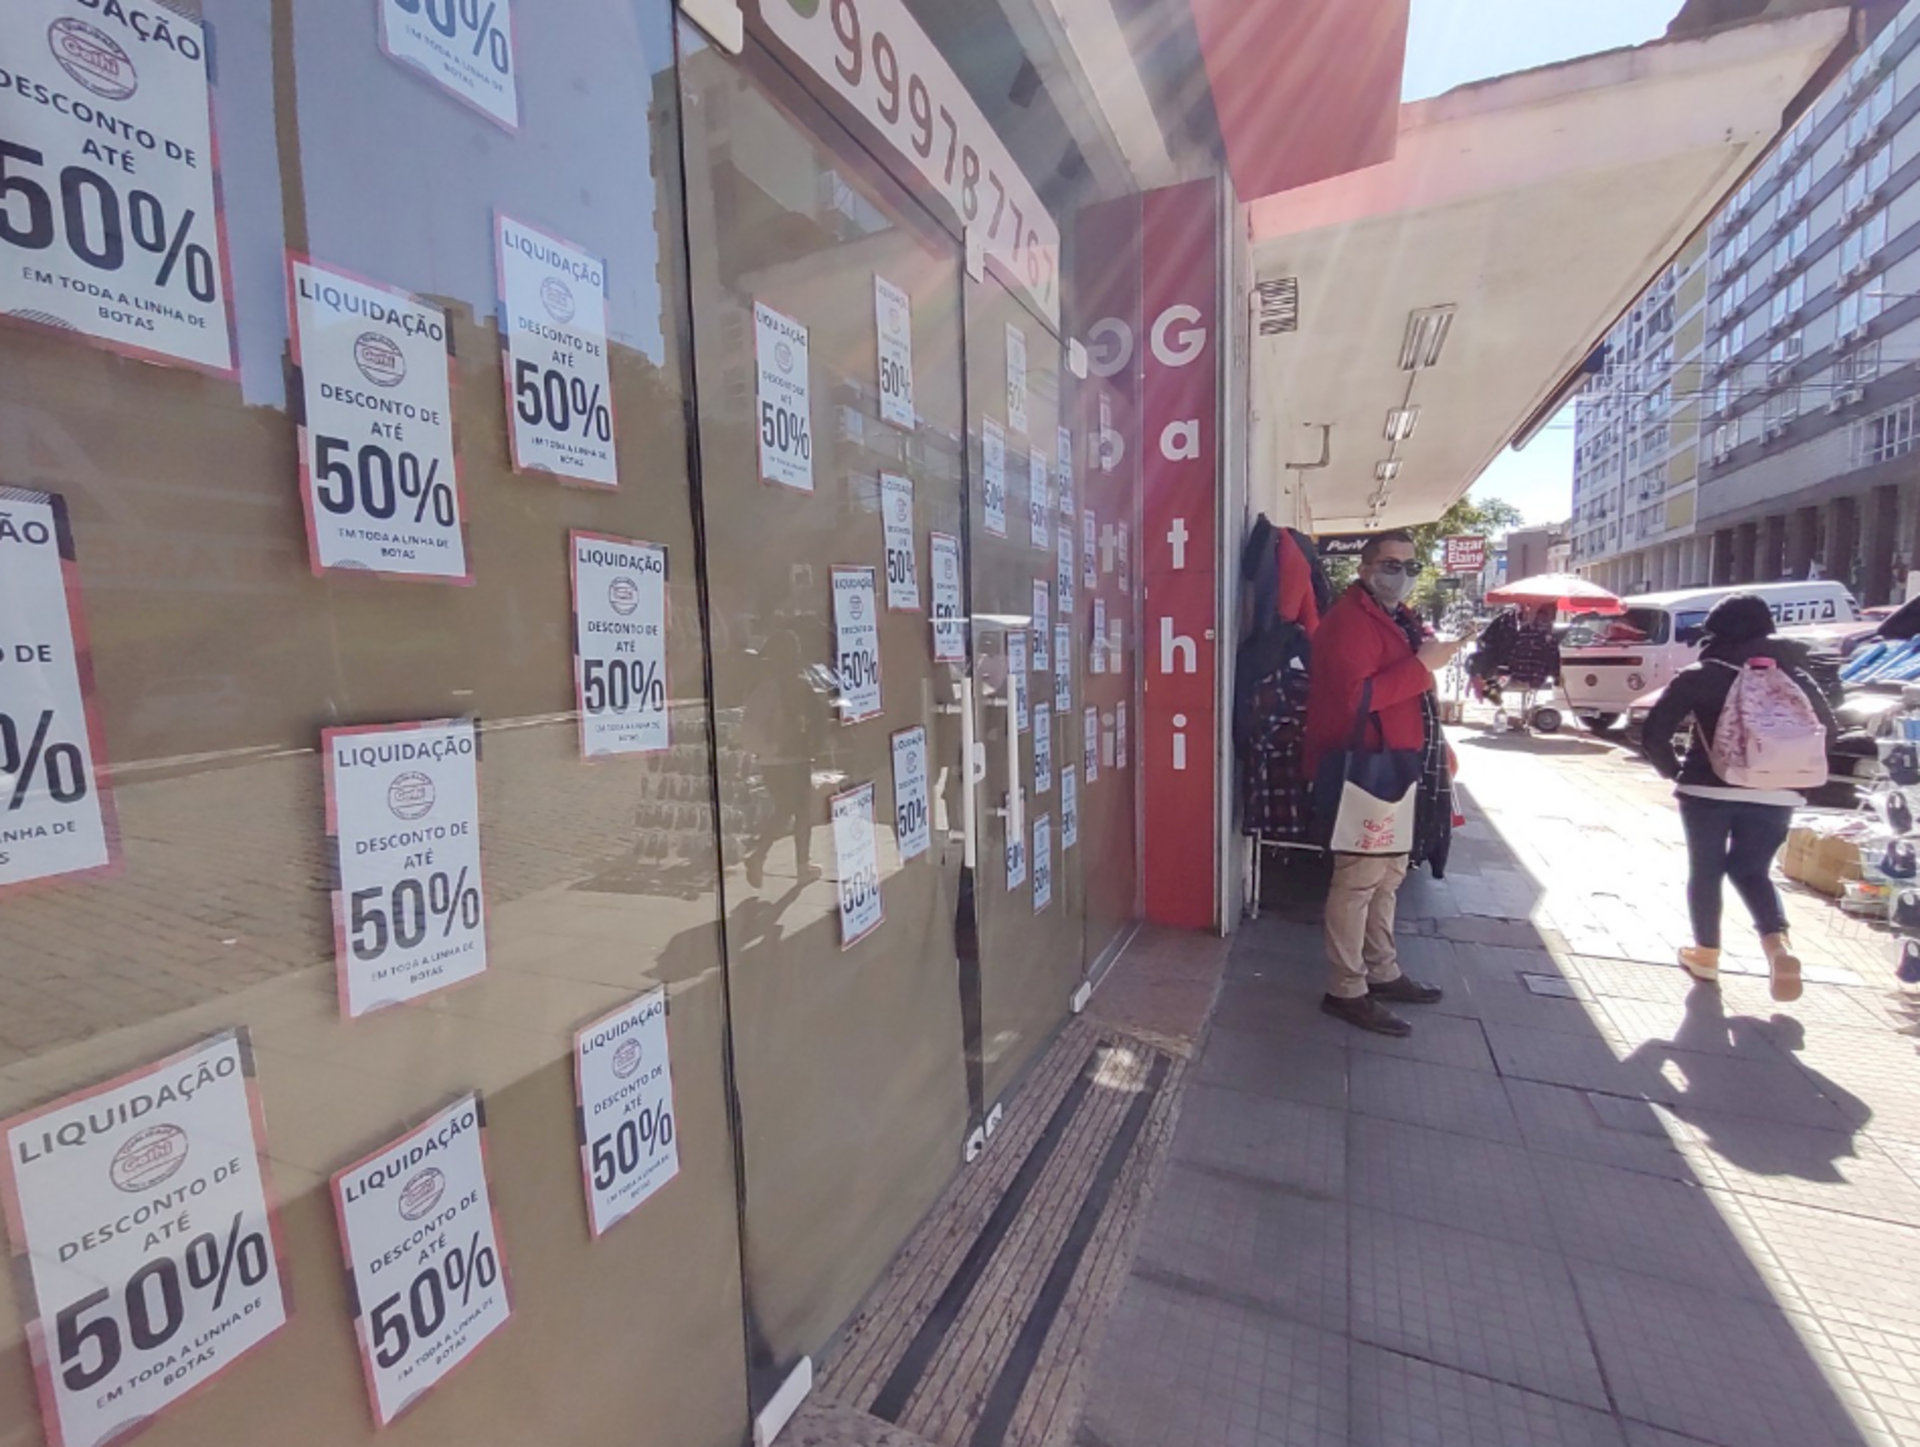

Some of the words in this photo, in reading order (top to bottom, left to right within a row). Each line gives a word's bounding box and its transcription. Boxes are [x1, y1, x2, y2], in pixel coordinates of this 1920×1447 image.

[76, 0, 201, 61] AÇÃO
[394, 0, 508, 74] 0%
[82, 138, 136, 174] ATÉ
[164, 140, 197, 168] DE
[0, 138, 215, 303] 50%
[505, 229, 601, 287] LIQUIDAÇÃO
[22, 266, 53, 285] EM
[59, 275, 113, 301] TODA
[117, 293, 130, 306] A
[132, 296, 185, 322] LINHA
[187, 315, 207, 329] DE
[300, 278, 443, 342] LIQUIDAÇÃO
[98, 306, 155, 331] BOTAS
[518, 316, 583, 350] DESCONTO
[585, 341, 600, 357] DE
[551, 349, 574, 368] ATÉ
[320, 383, 416, 418] DESCONTO
[420, 408, 440, 425] DE
[516, 358, 611, 442] 50%
[371, 421, 404, 441] ATÉ
[762, 400, 809, 461] 50%
[315, 434, 455, 527] 50%
[381, 548, 416, 559] BOTAS
[392, 534, 400, 542] A
[1150, 304, 1206, 770] Gathi
[1448, 540, 1482, 553] Bazar
[579, 548, 662, 575] LIQUIDAÇÃO
[1448, 552, 1483, 564] Elaine
[588, 620, 644, 634] DESCONTO
[646, 624, 658, 636] DE
[615, 639, 636, 652] ATÉ
[15, 644, 52, 663] DE
[841, 649, 878, 691] 50%
[584, 659, 664, 715] 50%
[338, 737, 472, 768] LIQUIDAÇÃO
[0, 822, 47, 844] NHA
[52, 820, 76, 835] DE
[356, 826, 446, 855] DESCONTO
[450, 821, 469, 836] DE
[898, 797, 927, 838] 50%
[403, 848, 434, 870] ATÉ
[351, 865, 480, 961] 50%
[410, 965, 444, 984] BOTAS
[422, 957, 430, 965] A
[582, 1000, 662, 1055] LIQUIDAÇÃO
[19, 1055, 236, 1164] LIQUIDAÇÃO
[594, 1073, 649, 1115] DESCONTO
[651, 1064, 663, 1080] DE
[622, 1094, 642, 1116] ATÉ
[345, 1111, 475, 1203] LIQUIDAÇÃO
[592, 1098, 672, 1191] 50%
[58, 1178, 206, 1264] DESCONTO
[213, 1157, 241, 1183] DE
[142, 1211, 192, 1253] ATÉ
[370, 1207, 456, 1275] DESCONTO
[460, 1189, 479, 1211] DE
[417, 1233, 448, 1266] ATÉ
[55, 1210, 269, 1392] 50%
[369, 1229, 497, 1370] 50%
[96, 1386, 123, 1409] EM
[127, 1353, 177, 1389] TODA
[179, 1342, 191, 1358] A
[194, 1310, 242, 1349] LINHA
[243, 1296, 263, 1316] DE
[163, 1346, 216, 1387] BOTAS
[436, 1336, 467, 1365] BOTAS
